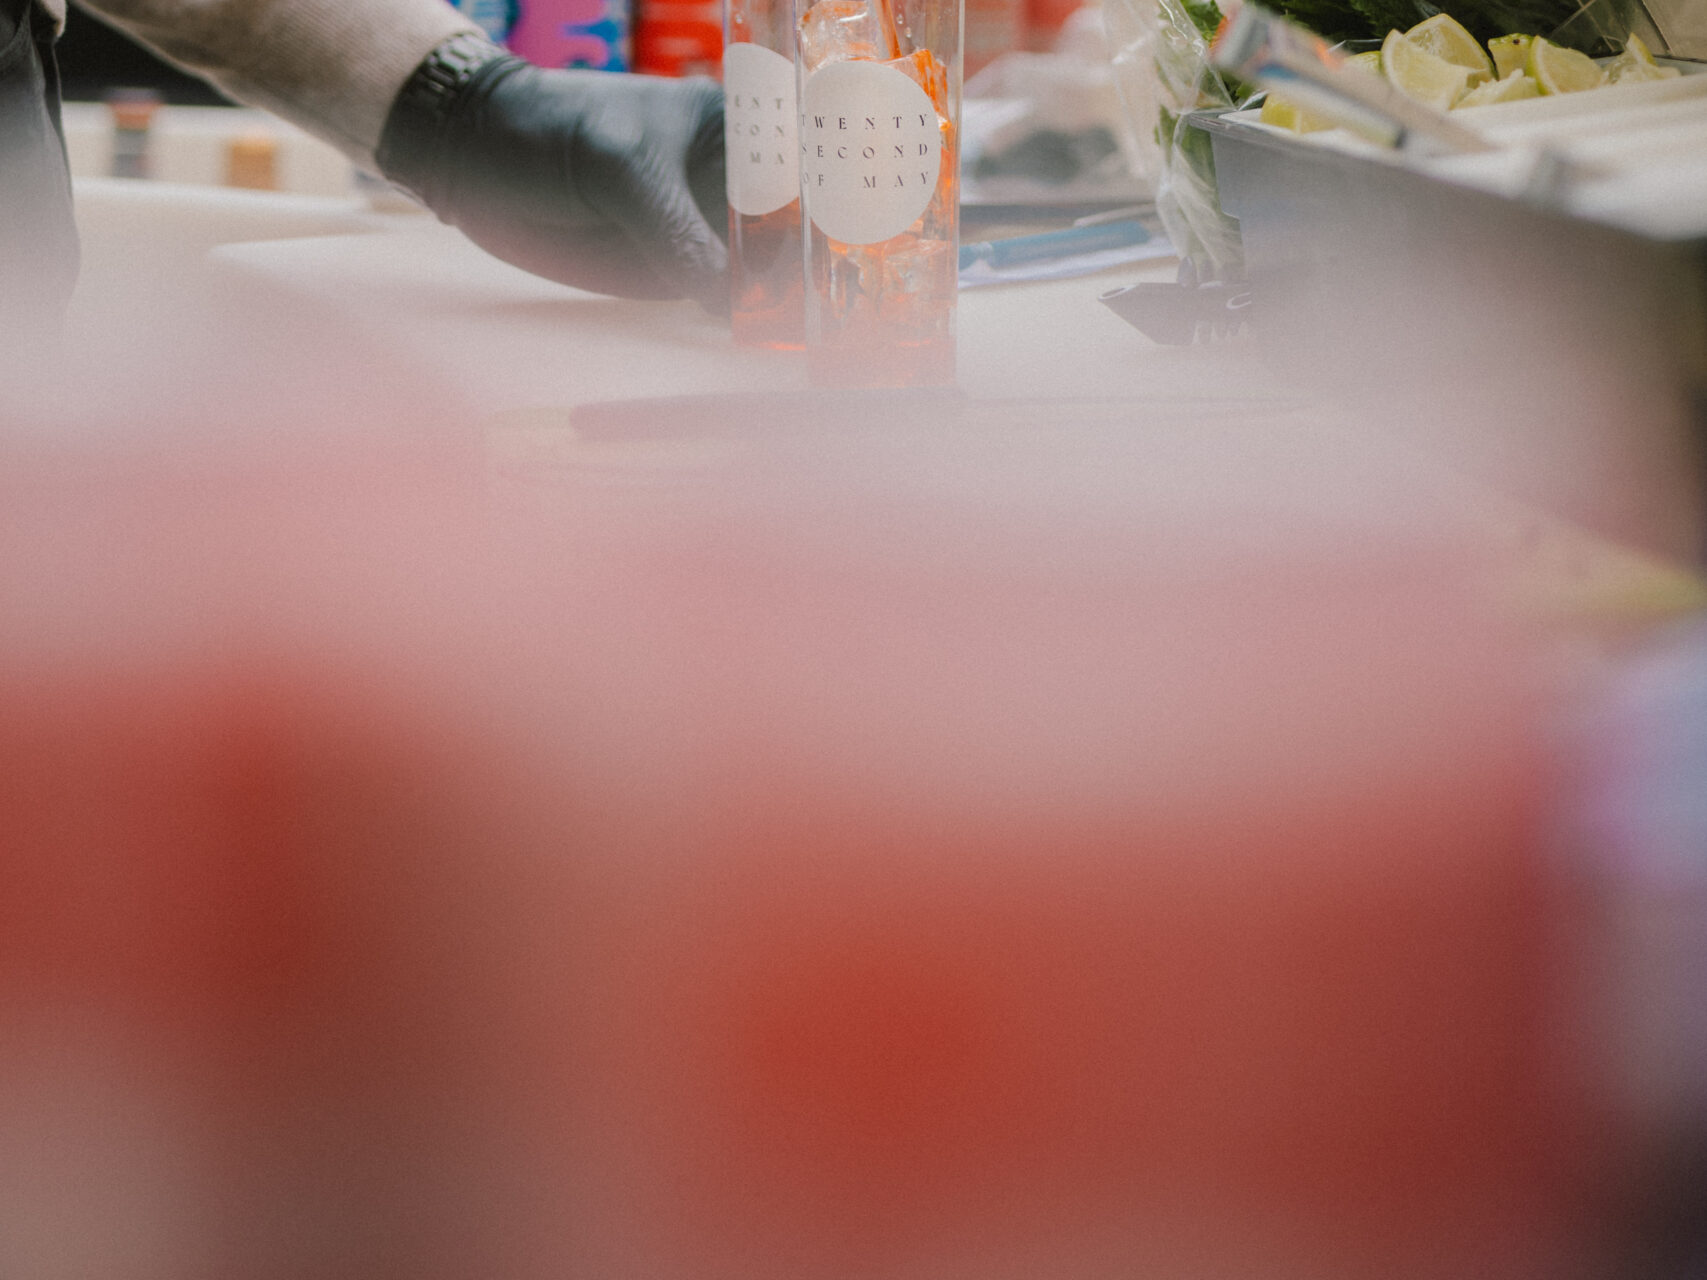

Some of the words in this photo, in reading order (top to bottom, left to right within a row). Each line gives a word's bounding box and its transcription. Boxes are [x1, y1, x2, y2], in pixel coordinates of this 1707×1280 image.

[801, 113, 928, 130] TWENTY
[750, 151, 785, 165] MA
[801, 143, 928, 160] SECOND
[863, 171, 929, 189] MAY
